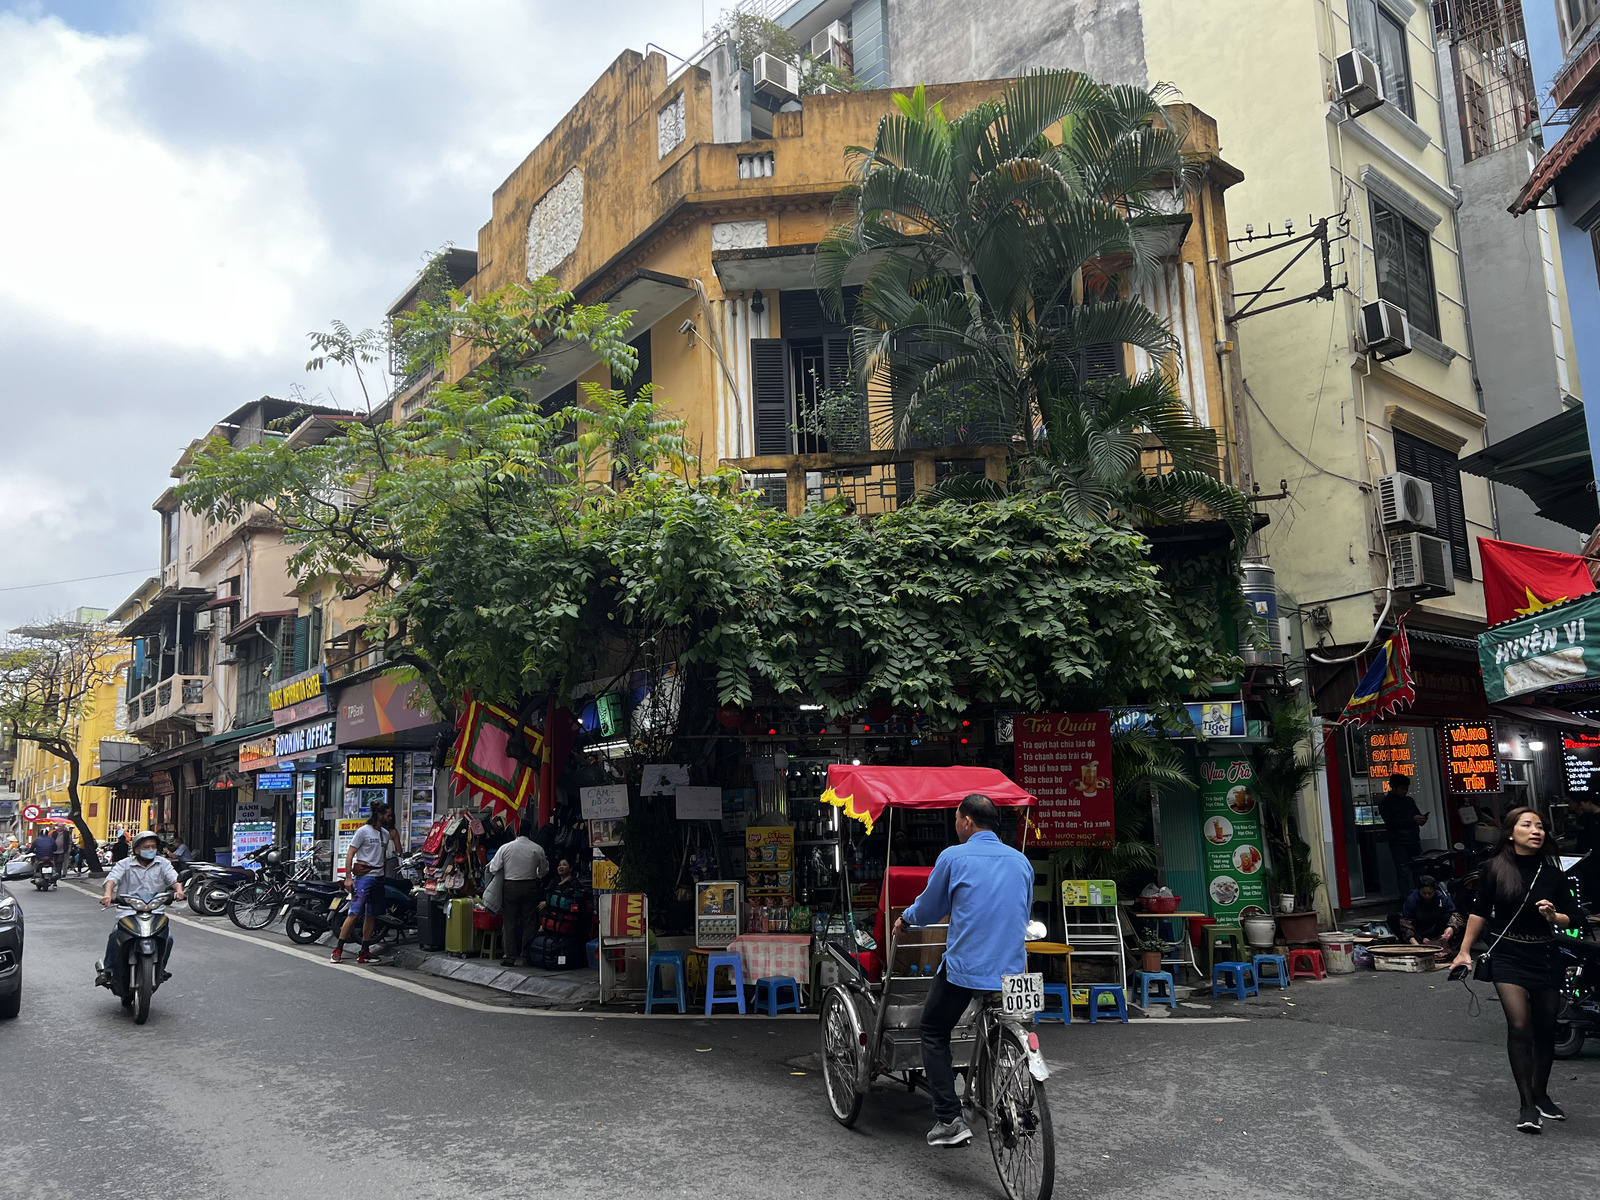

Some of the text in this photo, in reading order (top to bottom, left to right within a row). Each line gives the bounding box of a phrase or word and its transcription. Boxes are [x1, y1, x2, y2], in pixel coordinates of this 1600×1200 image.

[1495, 618, 1586, 665] HUYỀN VI
[1023, 717, 1096, 736] Trà Quán
[1203, 720, 1228, 735] Tiger
[1450, 726, 1488, 742] VÀNG
[276, 730, 304, 757] BOOKING
[306, 722, 332, 750] OFFICE
[1452, 743, 1489, 758] HƯNG
[349, 756, 394, 772] BOOKING OFFICE
[1202, 760, 1252, 784] Vua Trà
[1451, 758, 1495, 774] THÀNH
[348, 774, 394, 785] MONEY EXCHANGE
[1463, 774, 1486, 790] TÍN
[1010, 978, 1036, 993] 29XL
[1007, 994, 1040, 1010] 0058
